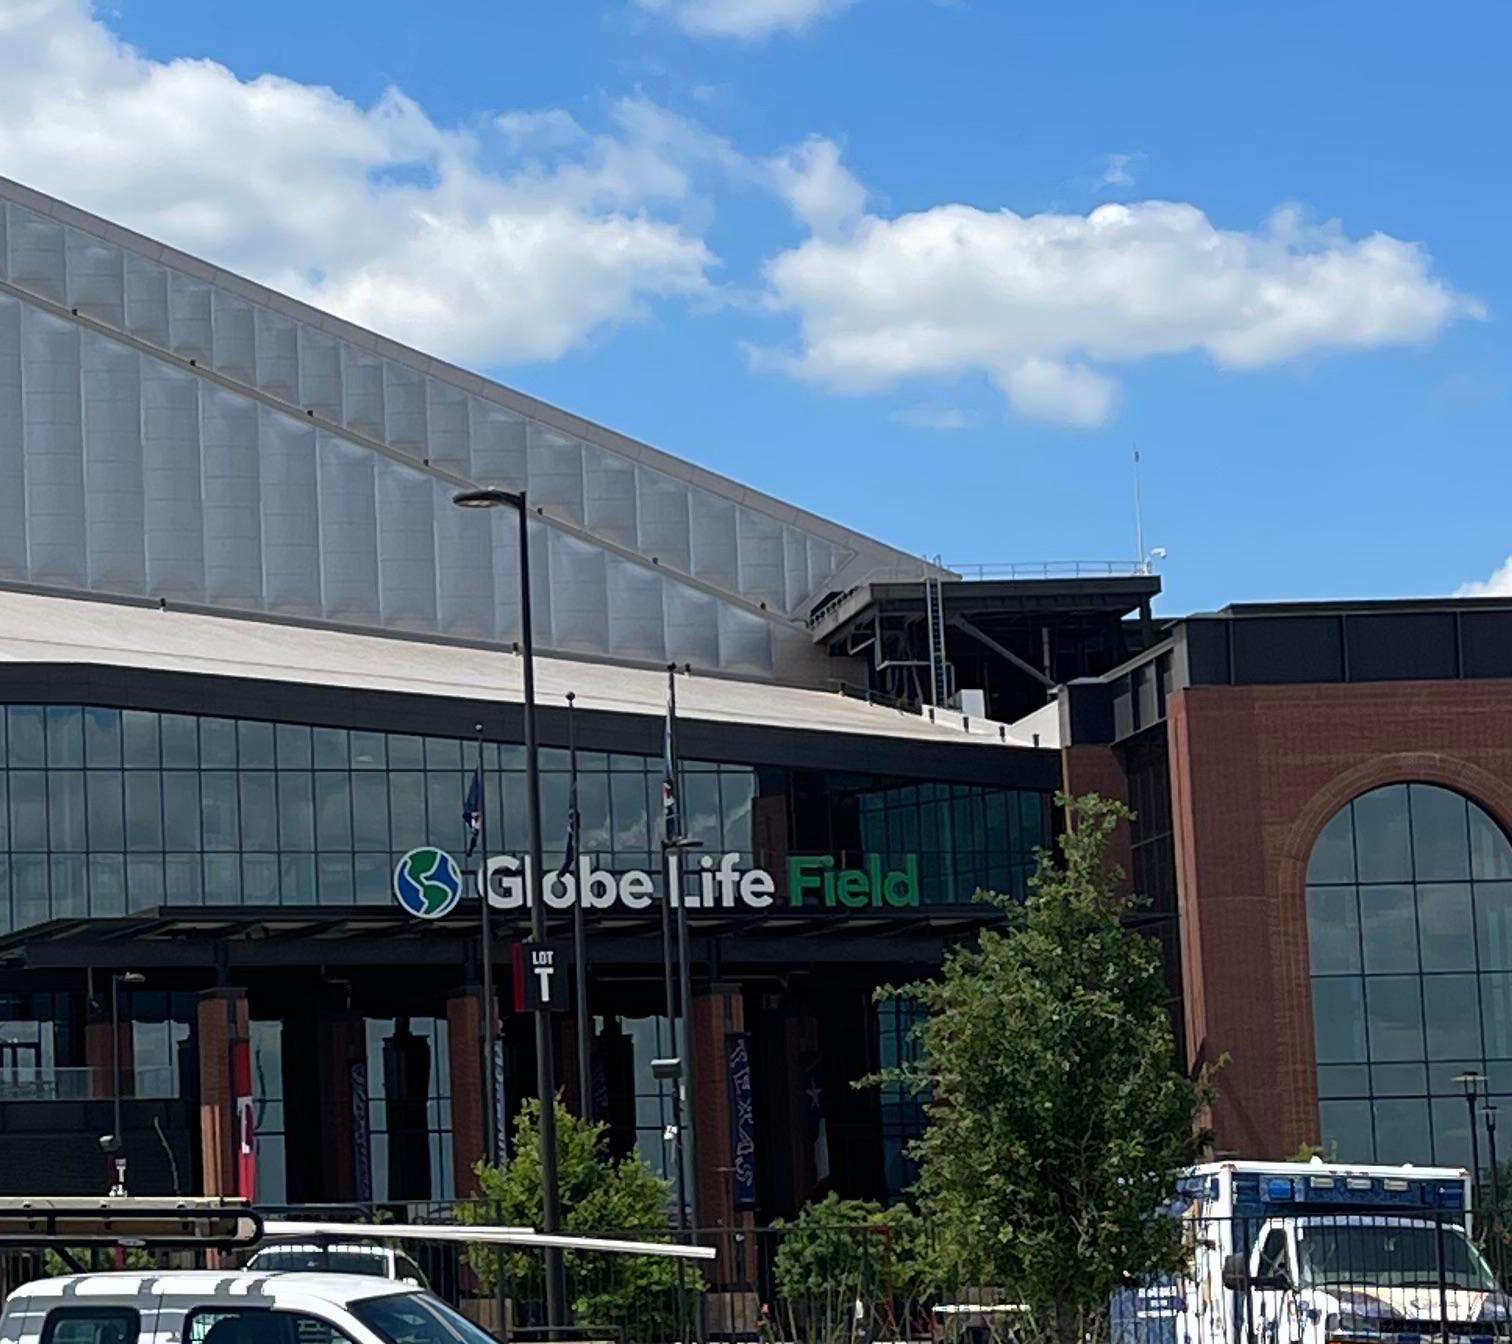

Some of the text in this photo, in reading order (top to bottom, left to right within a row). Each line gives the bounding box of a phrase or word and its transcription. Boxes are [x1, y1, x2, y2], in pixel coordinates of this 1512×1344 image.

[478, 852, 920, 909] Globe Life Field
[532, 951, 554, 965] LOT
[534, 967, 554, 1003] T
